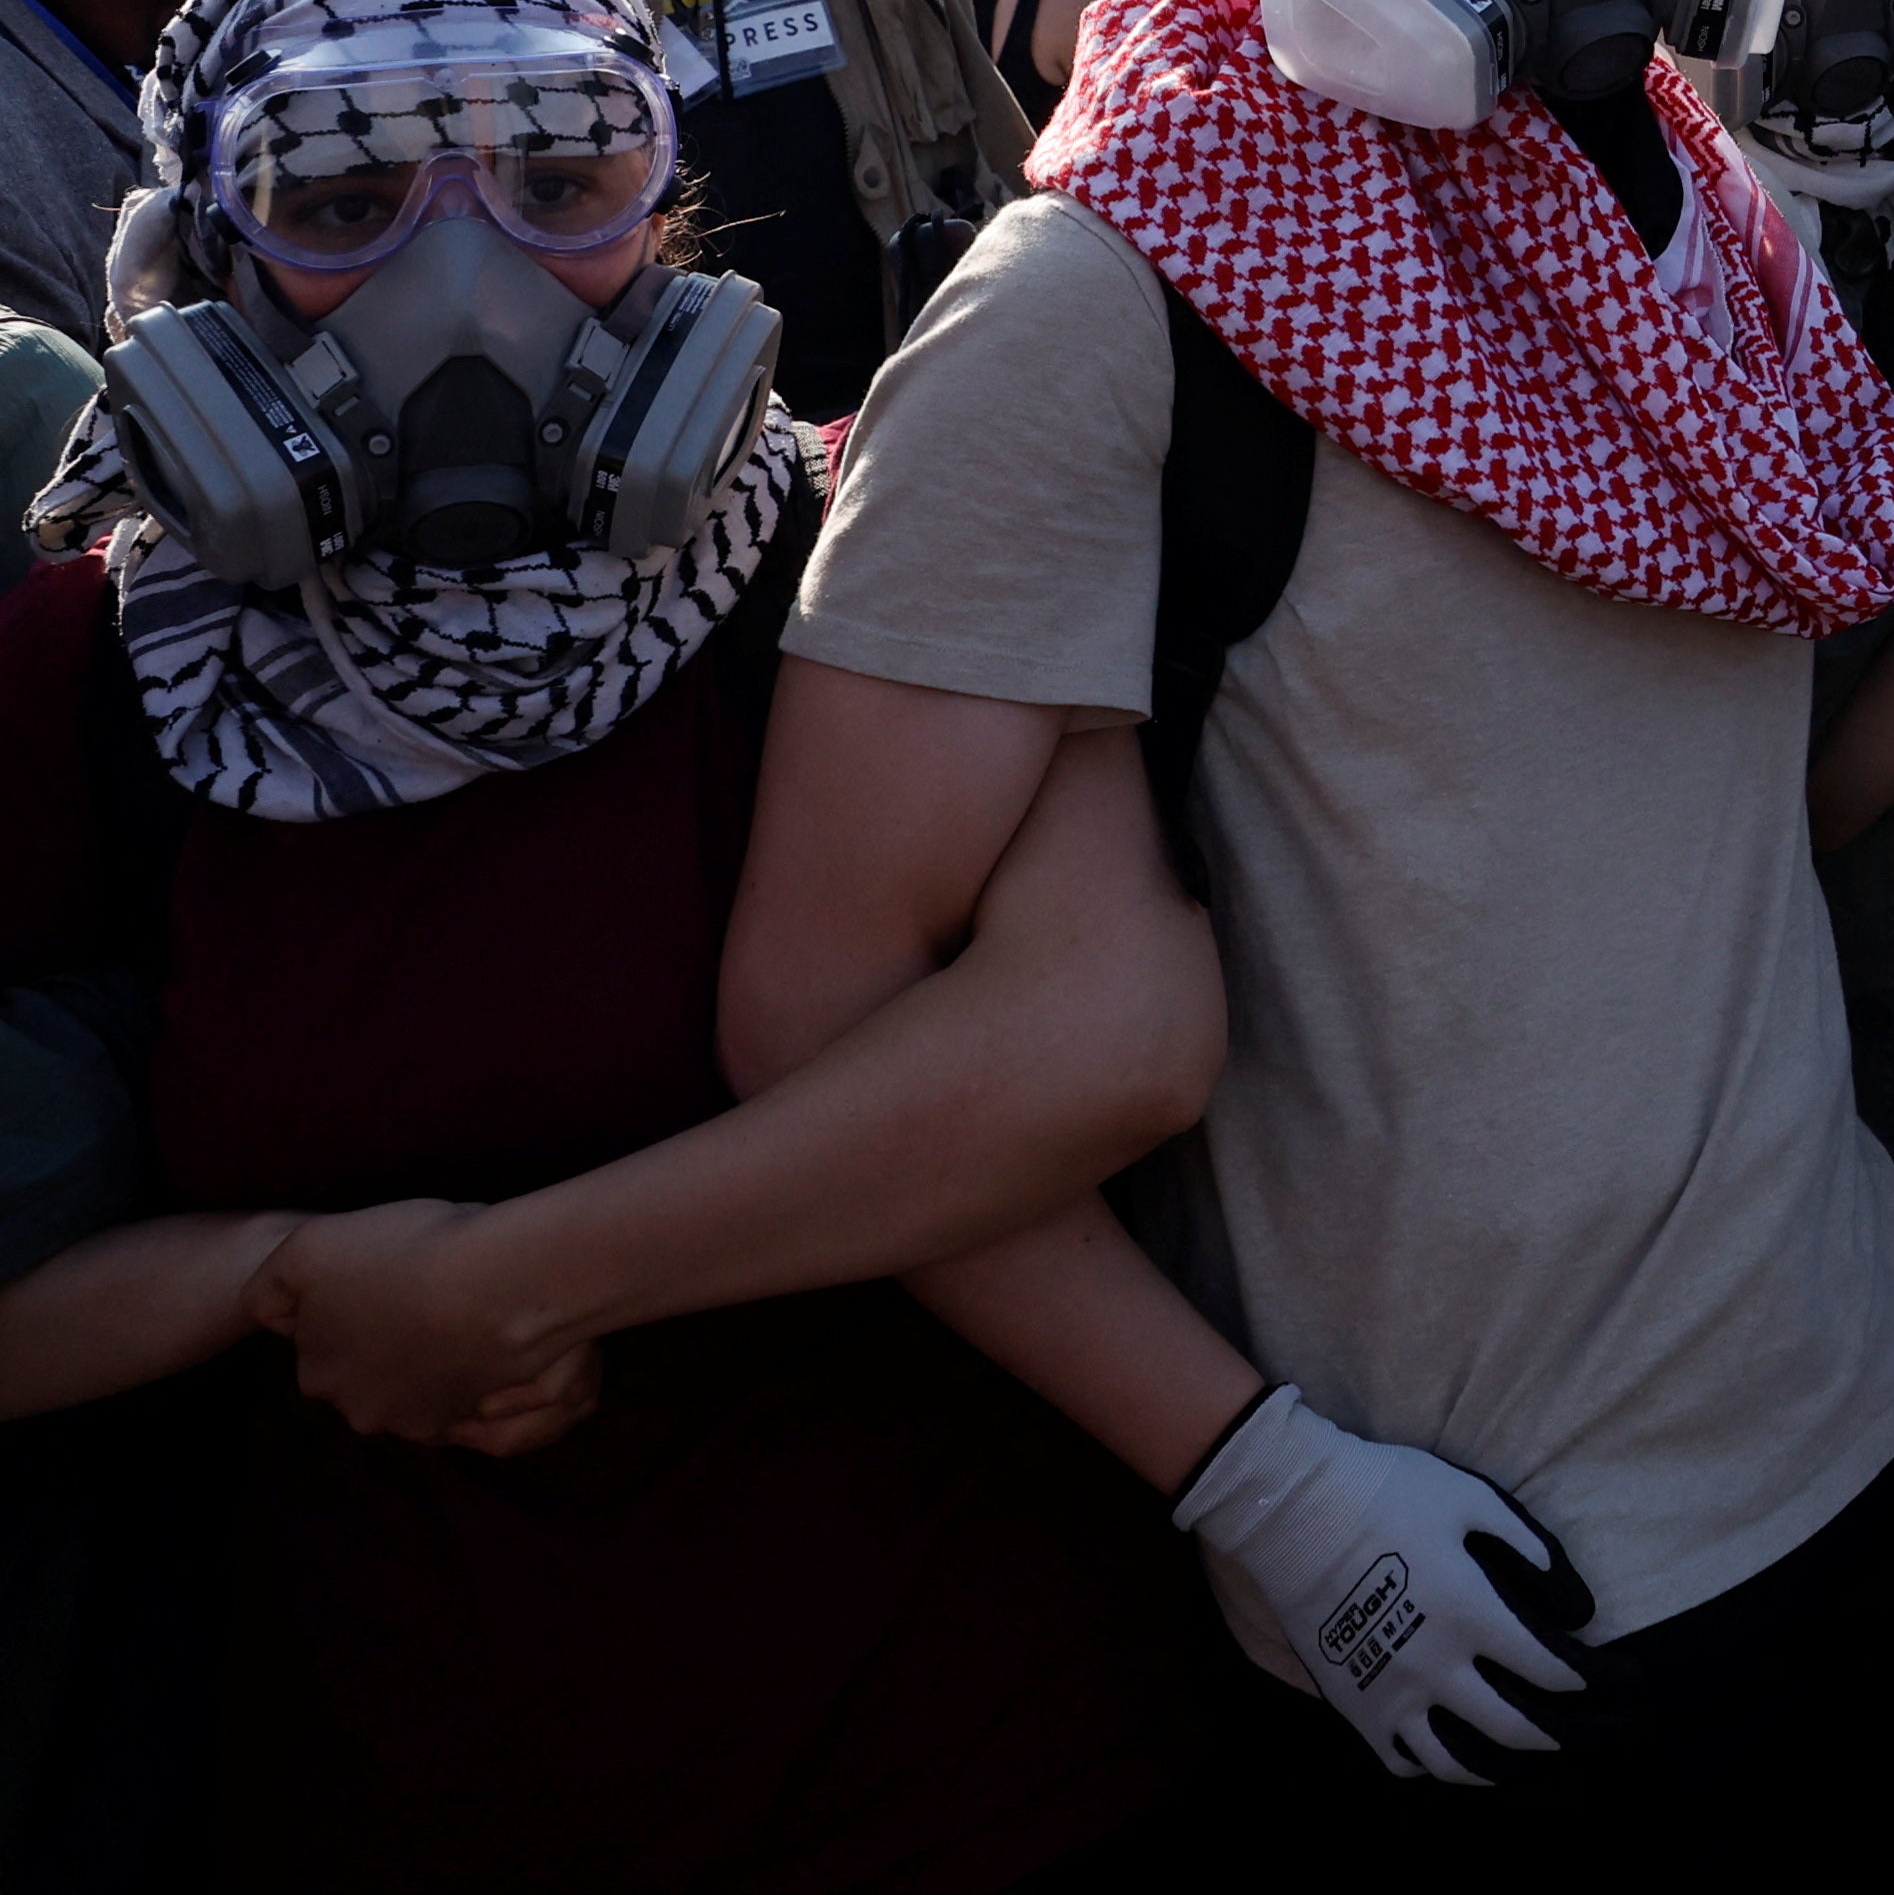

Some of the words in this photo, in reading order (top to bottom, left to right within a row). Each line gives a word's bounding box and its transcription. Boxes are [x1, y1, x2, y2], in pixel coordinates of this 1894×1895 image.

[724, 13, 818, 46] PRESS
[1325, 1603, 1359, 1643] HYPER
[1329, 1576, 1397, 1653] TOUGH
